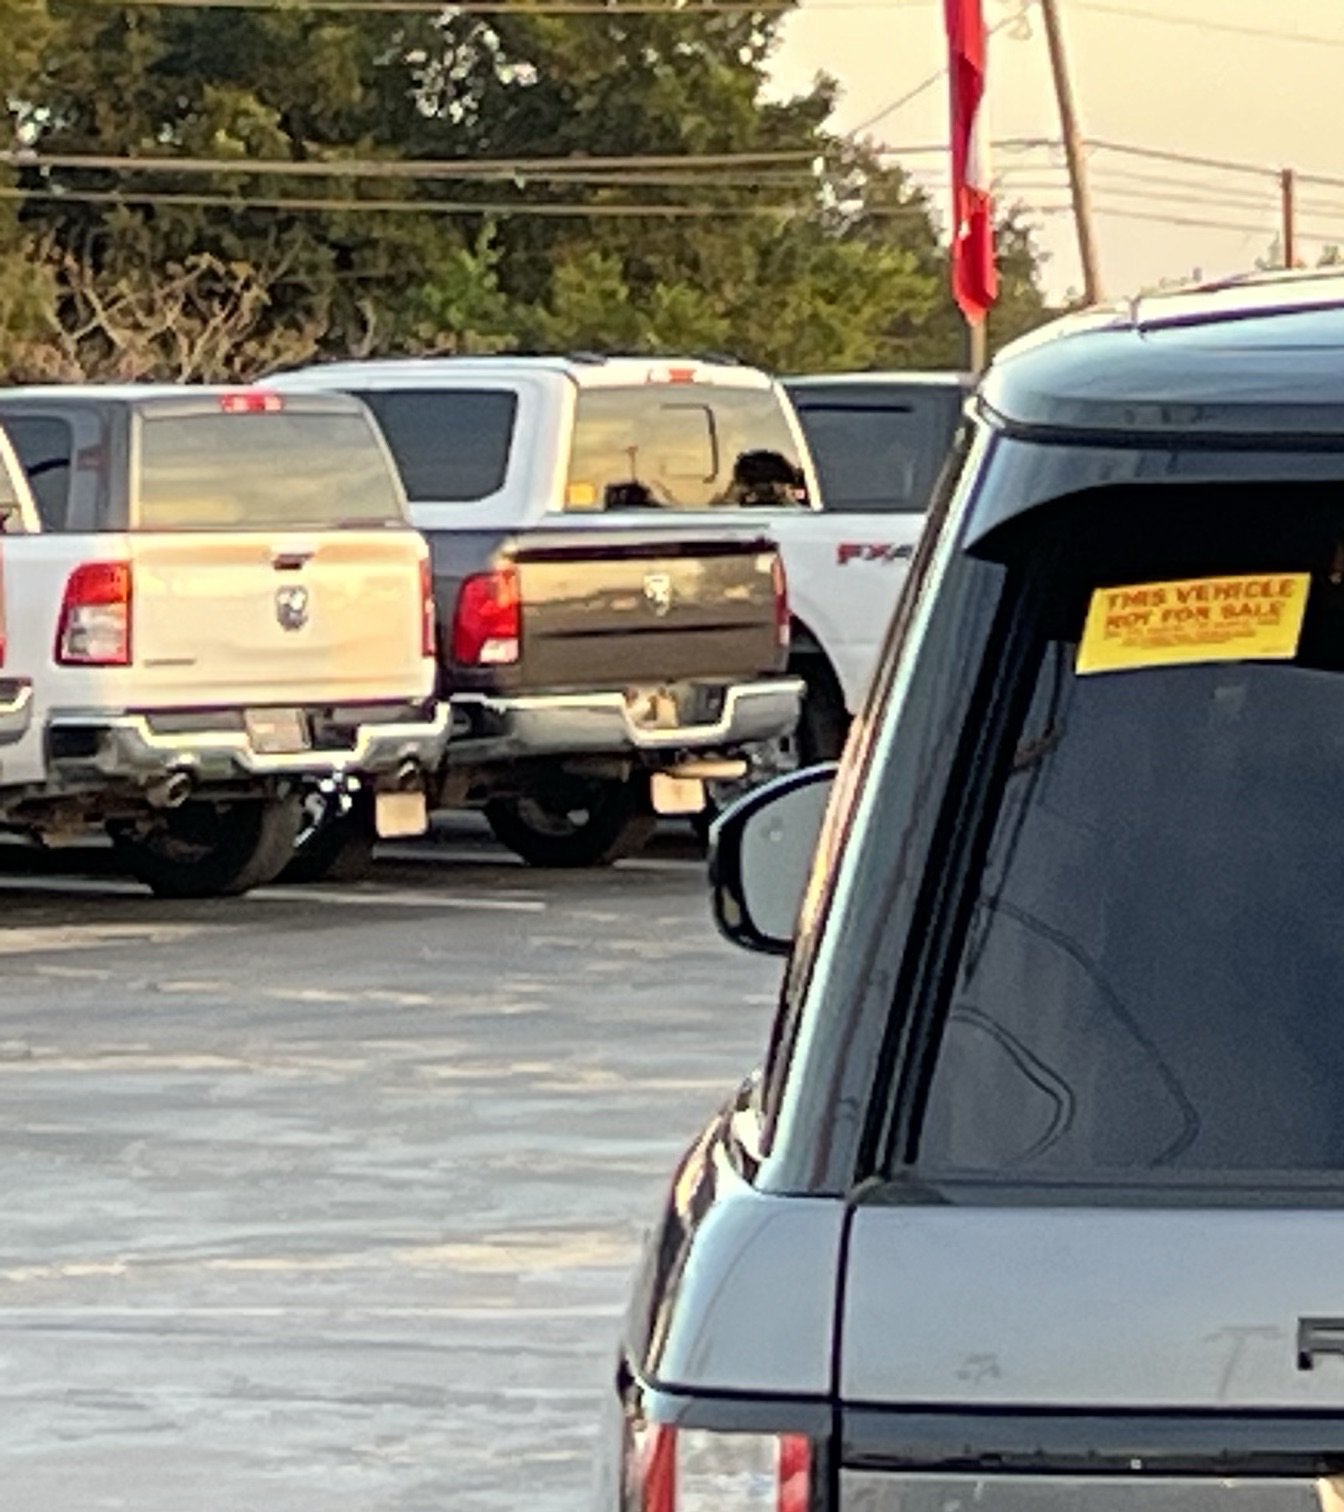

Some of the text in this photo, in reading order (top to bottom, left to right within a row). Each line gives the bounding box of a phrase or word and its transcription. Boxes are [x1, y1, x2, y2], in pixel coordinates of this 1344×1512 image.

[1107, 580, 1294, 610] THIS VEHICLE
[1106, 602, 1284, 629] NOT FOR SALE
